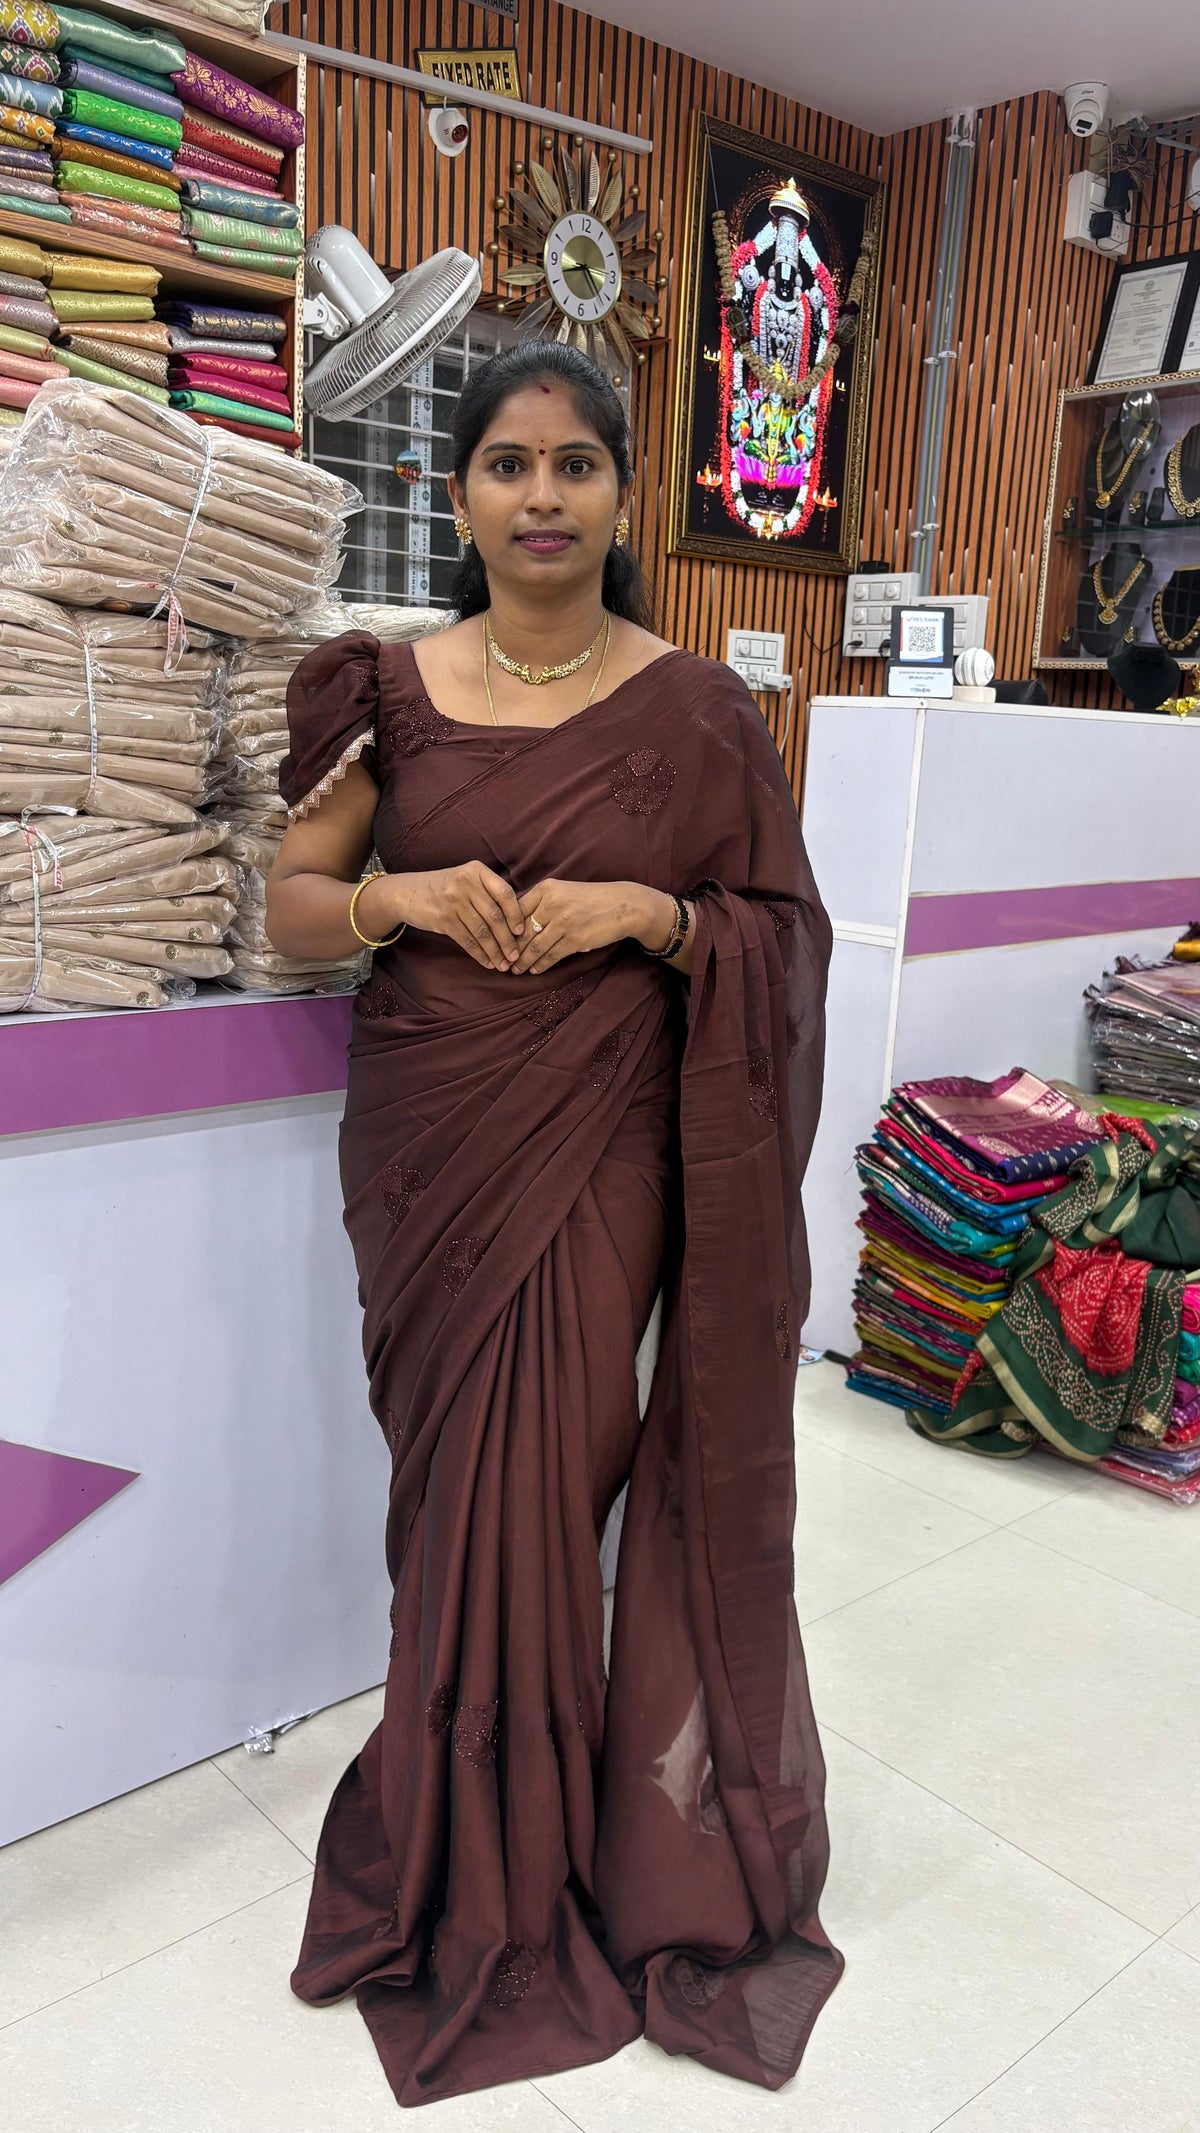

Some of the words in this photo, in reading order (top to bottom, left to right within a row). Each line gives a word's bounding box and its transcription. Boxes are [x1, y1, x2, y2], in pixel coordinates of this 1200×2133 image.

[475, 62, 511, 90] RATE
[581, 218, 592, 234] 12
[550, 251, 558, 266] 9
[608, 270, 616, 285] 3
[577, 302, 584, 317] 6
